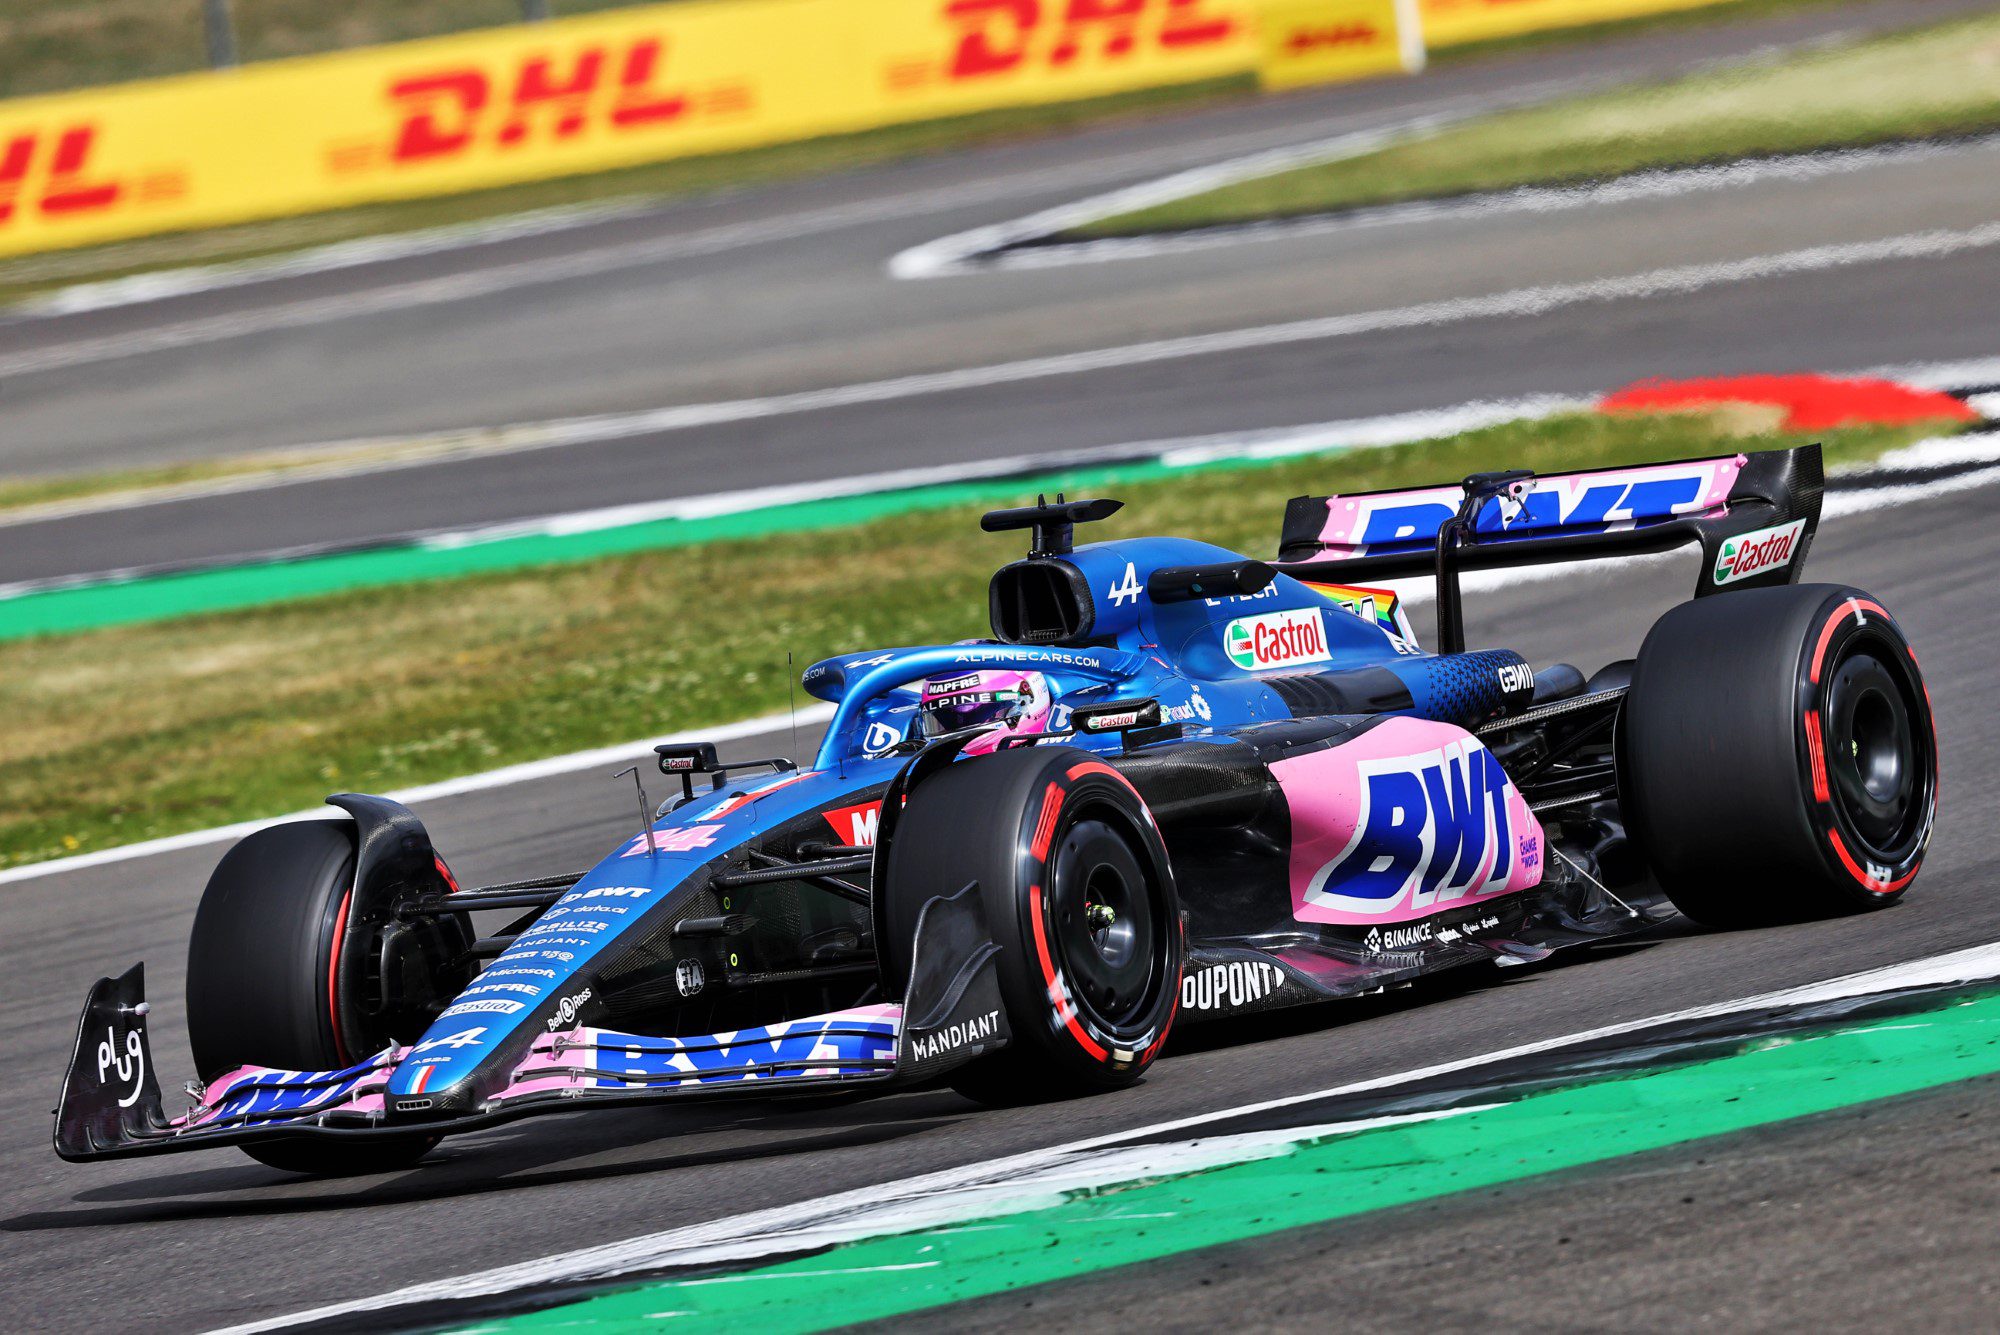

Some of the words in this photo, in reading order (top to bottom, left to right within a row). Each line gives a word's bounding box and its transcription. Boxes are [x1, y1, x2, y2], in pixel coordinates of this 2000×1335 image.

[388, 38, 688, 162] DHL
[1732, 526, 1799, 576] Castrol
[1254, 614, 1325, 665] Castrol
[954, 651, 1101, 669] ALPINECARS.COM
[921, 692, 993, 713] ALPINE
[928, 675, 980, 695] MAPFRE
[1100, 714, 1135, 728] Castrol
[669, 758, 694, 770] Castrol
[1320, 747, 1510, 901] BWT
[582, 886, 652, 899] BWT
[1383, 922, 1433, 950] BINANCE
[487, 968, 557, 979] Microsoft
[1181, 962, 1274, 1011] DUPONT
[547, 1012, 565, 1032] Bell
[573, 987, 592, 1010] Ross
[911, 1010, 1000, 1062] MANDIANT
[97, 1026, 144, 1108] plug
